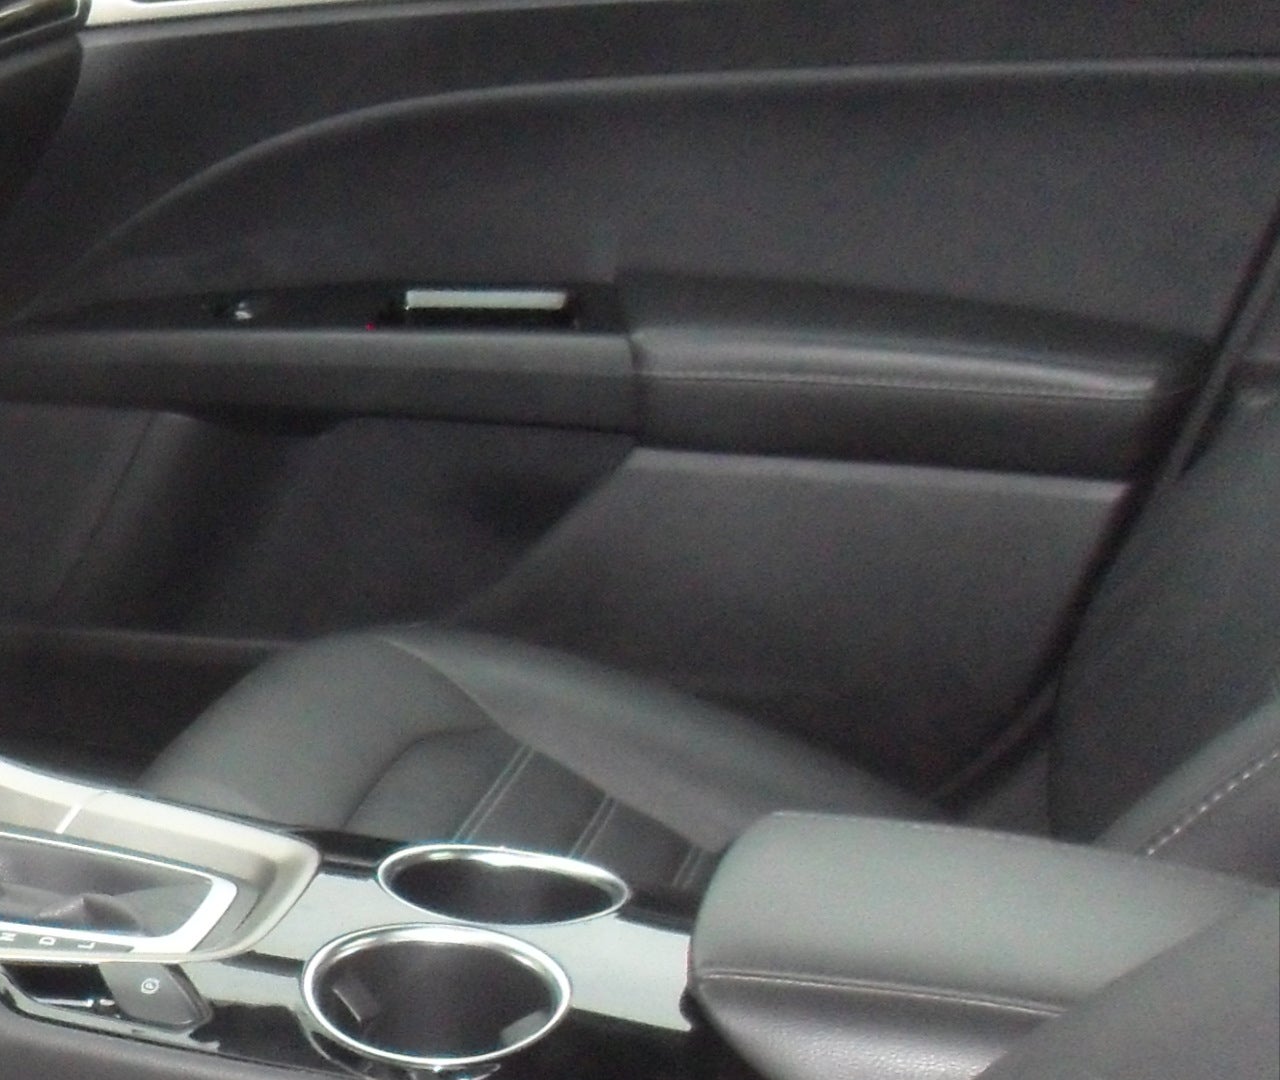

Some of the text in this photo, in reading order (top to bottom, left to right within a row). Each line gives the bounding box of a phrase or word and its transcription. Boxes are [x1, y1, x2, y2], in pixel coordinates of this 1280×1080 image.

[0, 932, 17, 942] N
[39, 936, 56, 946] D
[77, 941, 95, 950] L
